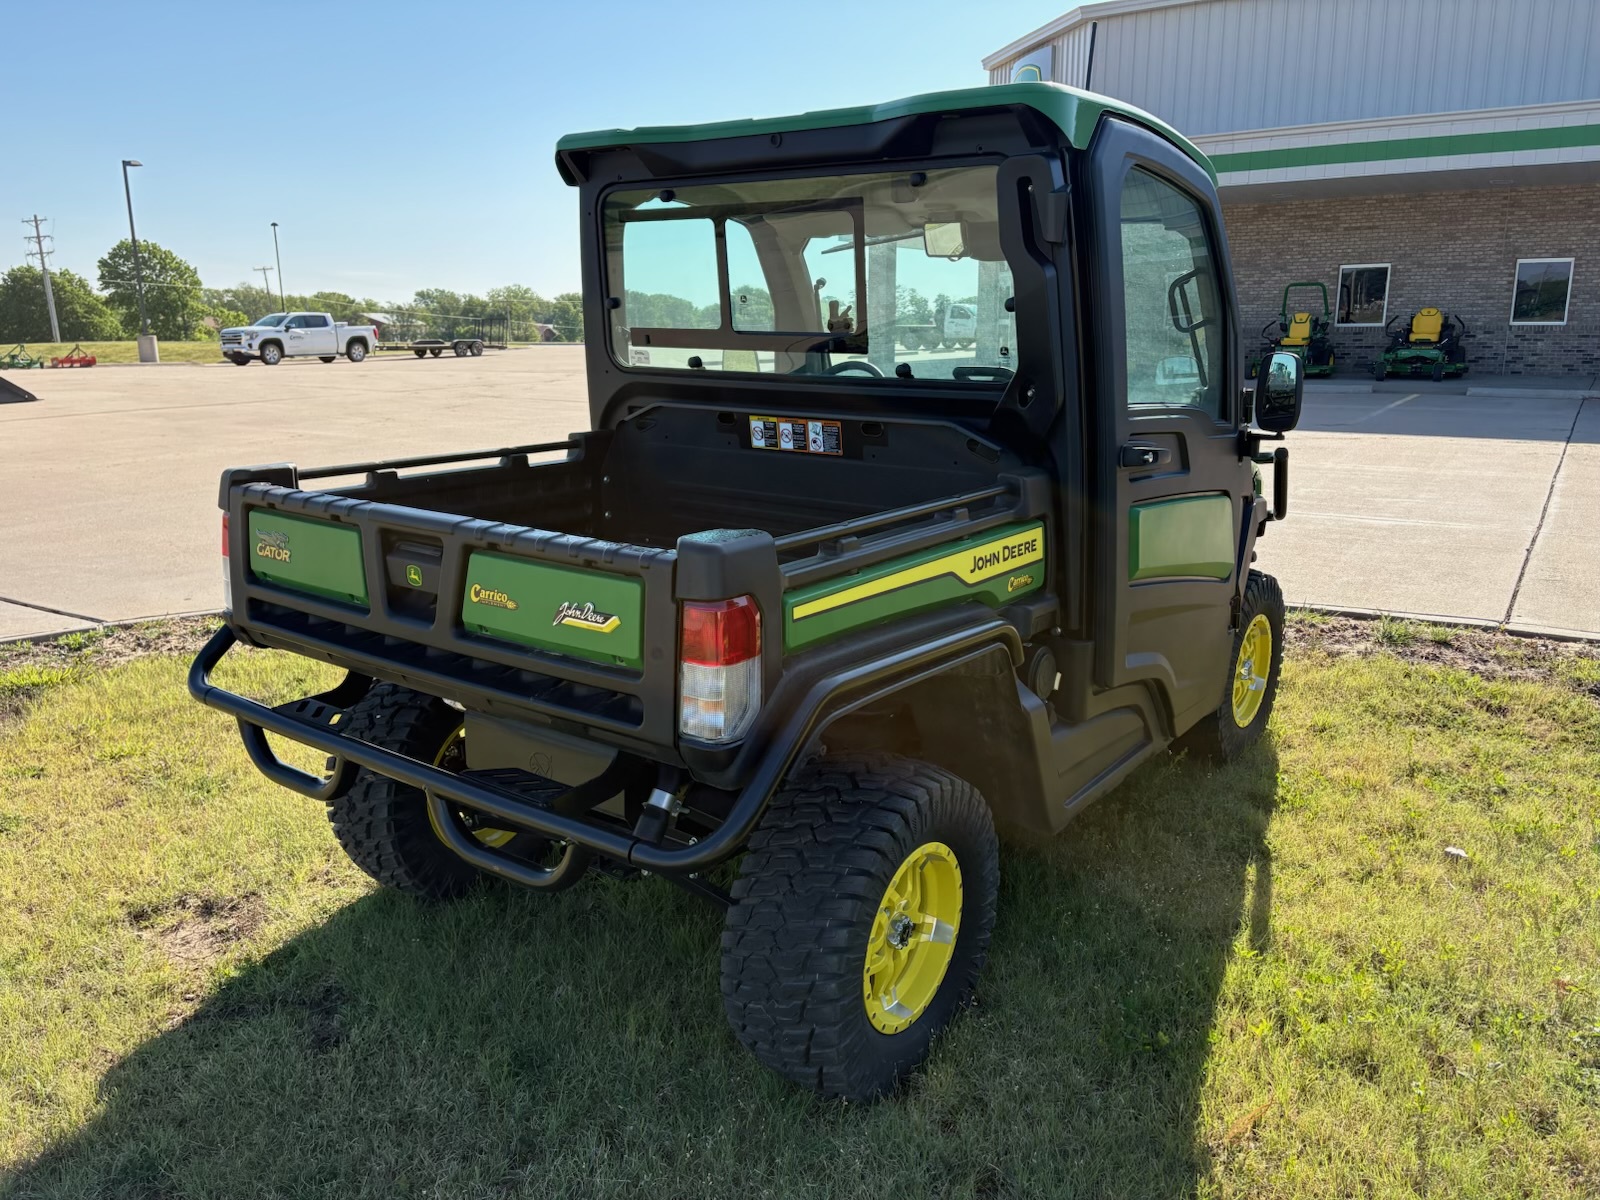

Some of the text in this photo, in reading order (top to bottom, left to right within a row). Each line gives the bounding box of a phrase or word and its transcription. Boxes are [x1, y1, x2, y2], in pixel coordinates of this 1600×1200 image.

[256, 542, 291, 563] GATOR
[970, 538, 1037, 574] JOHN DEERE
[470, 583, 508, 603] Carrico
